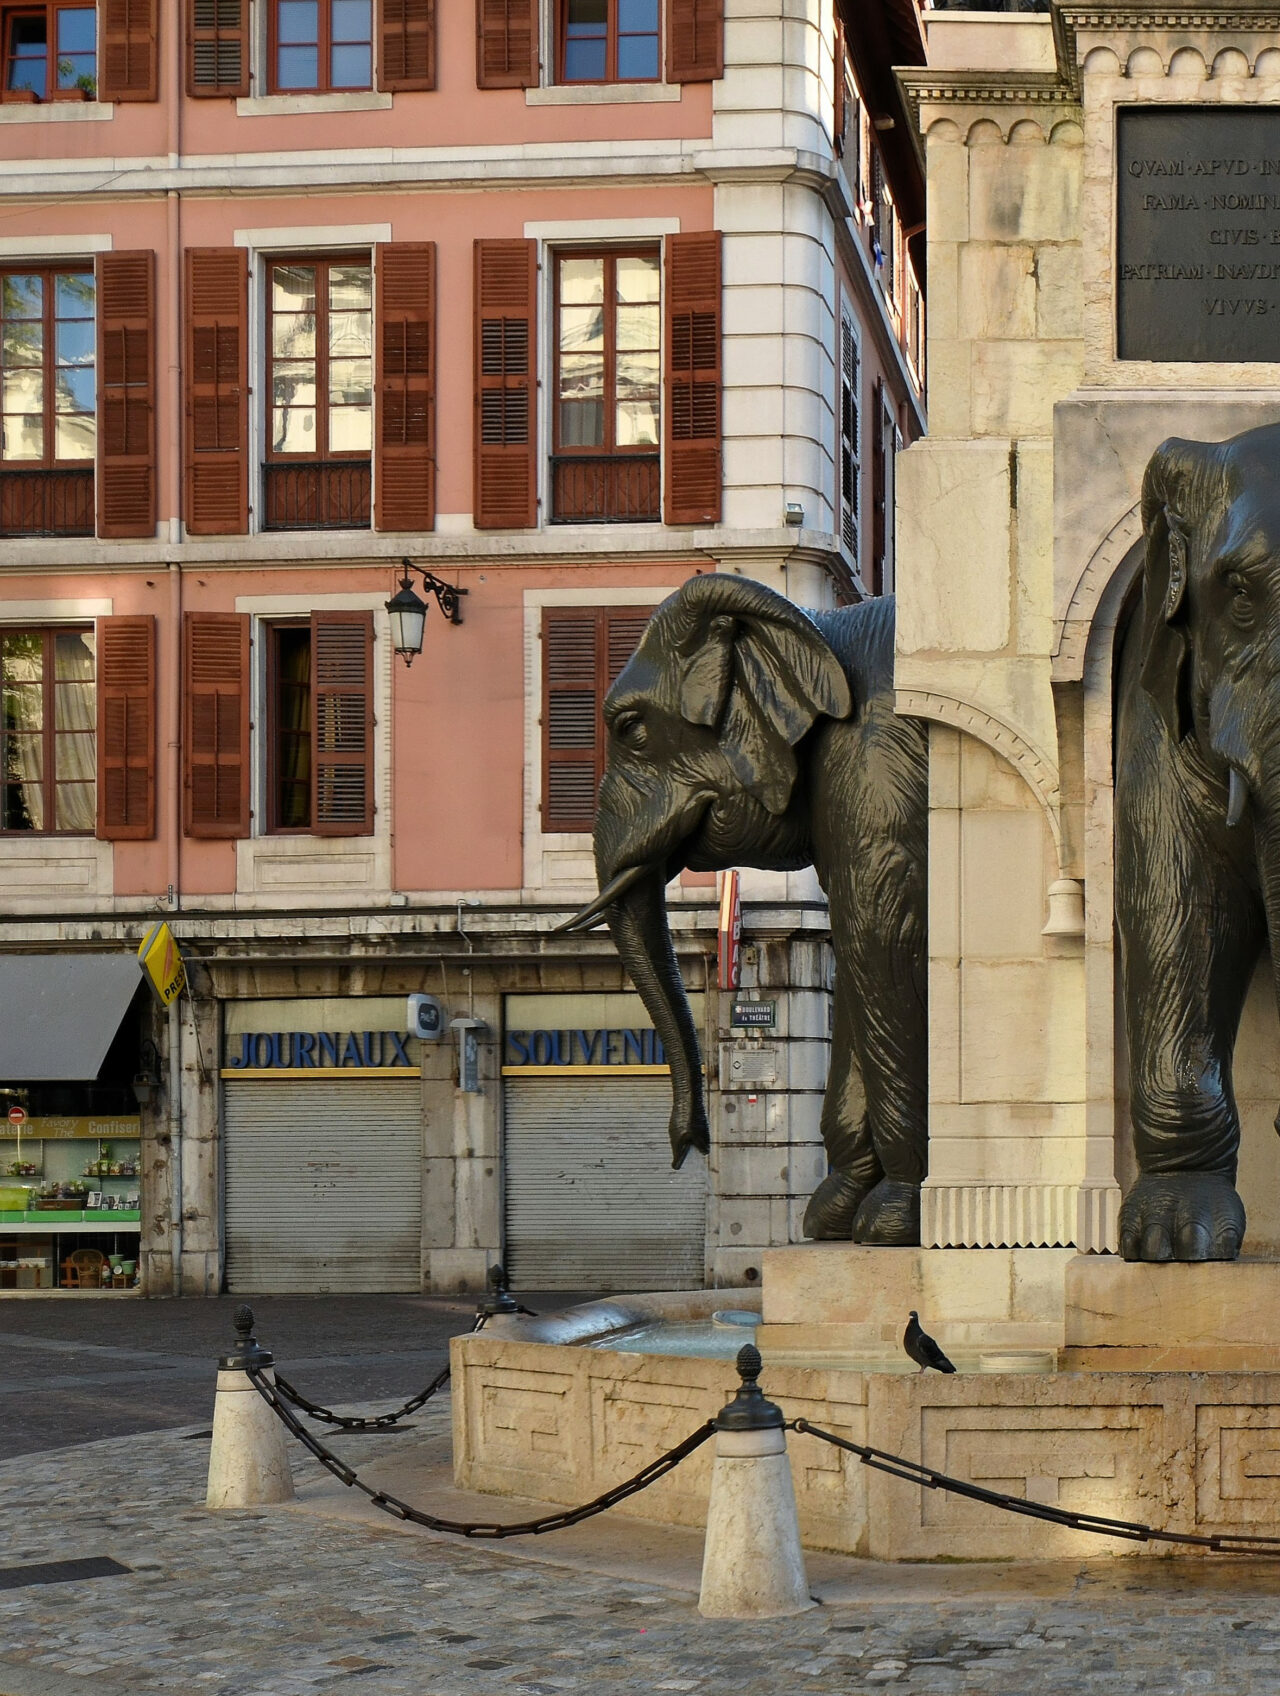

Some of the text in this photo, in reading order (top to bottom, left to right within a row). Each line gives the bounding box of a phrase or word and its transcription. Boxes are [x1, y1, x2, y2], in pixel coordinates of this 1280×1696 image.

[1128, 160, 1184, 178] QVAM
[1193, 160, 1249, 176] APVD
[1142, 194, 1200, 211] FAMA
[1208, 229, 1259, 245] CIVIS
[1119, 263, 1203, 280] PATRIAM
[1203, 299, 1268, 316] VIVVS
[230, 1031, 411, 1068] JOURNAUX
[508, 1029, 666, 1066] SOUVENI
